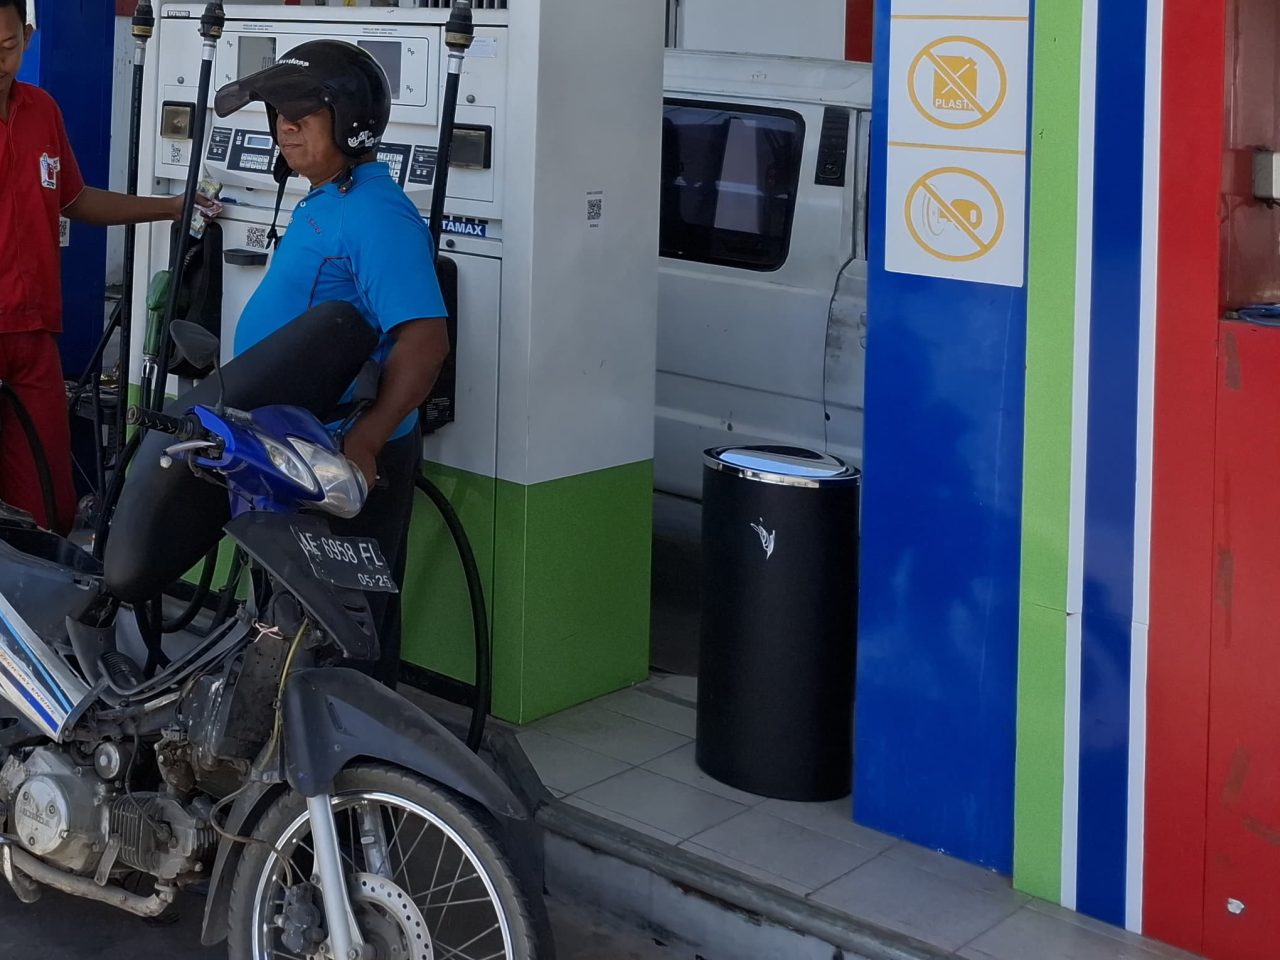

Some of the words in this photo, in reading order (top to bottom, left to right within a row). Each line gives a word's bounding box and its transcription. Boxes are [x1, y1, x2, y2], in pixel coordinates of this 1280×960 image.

[299, 532, 320, 556] AE
[321, 537, 358, 564] 6958
[359, 543, 384, 567] FL
